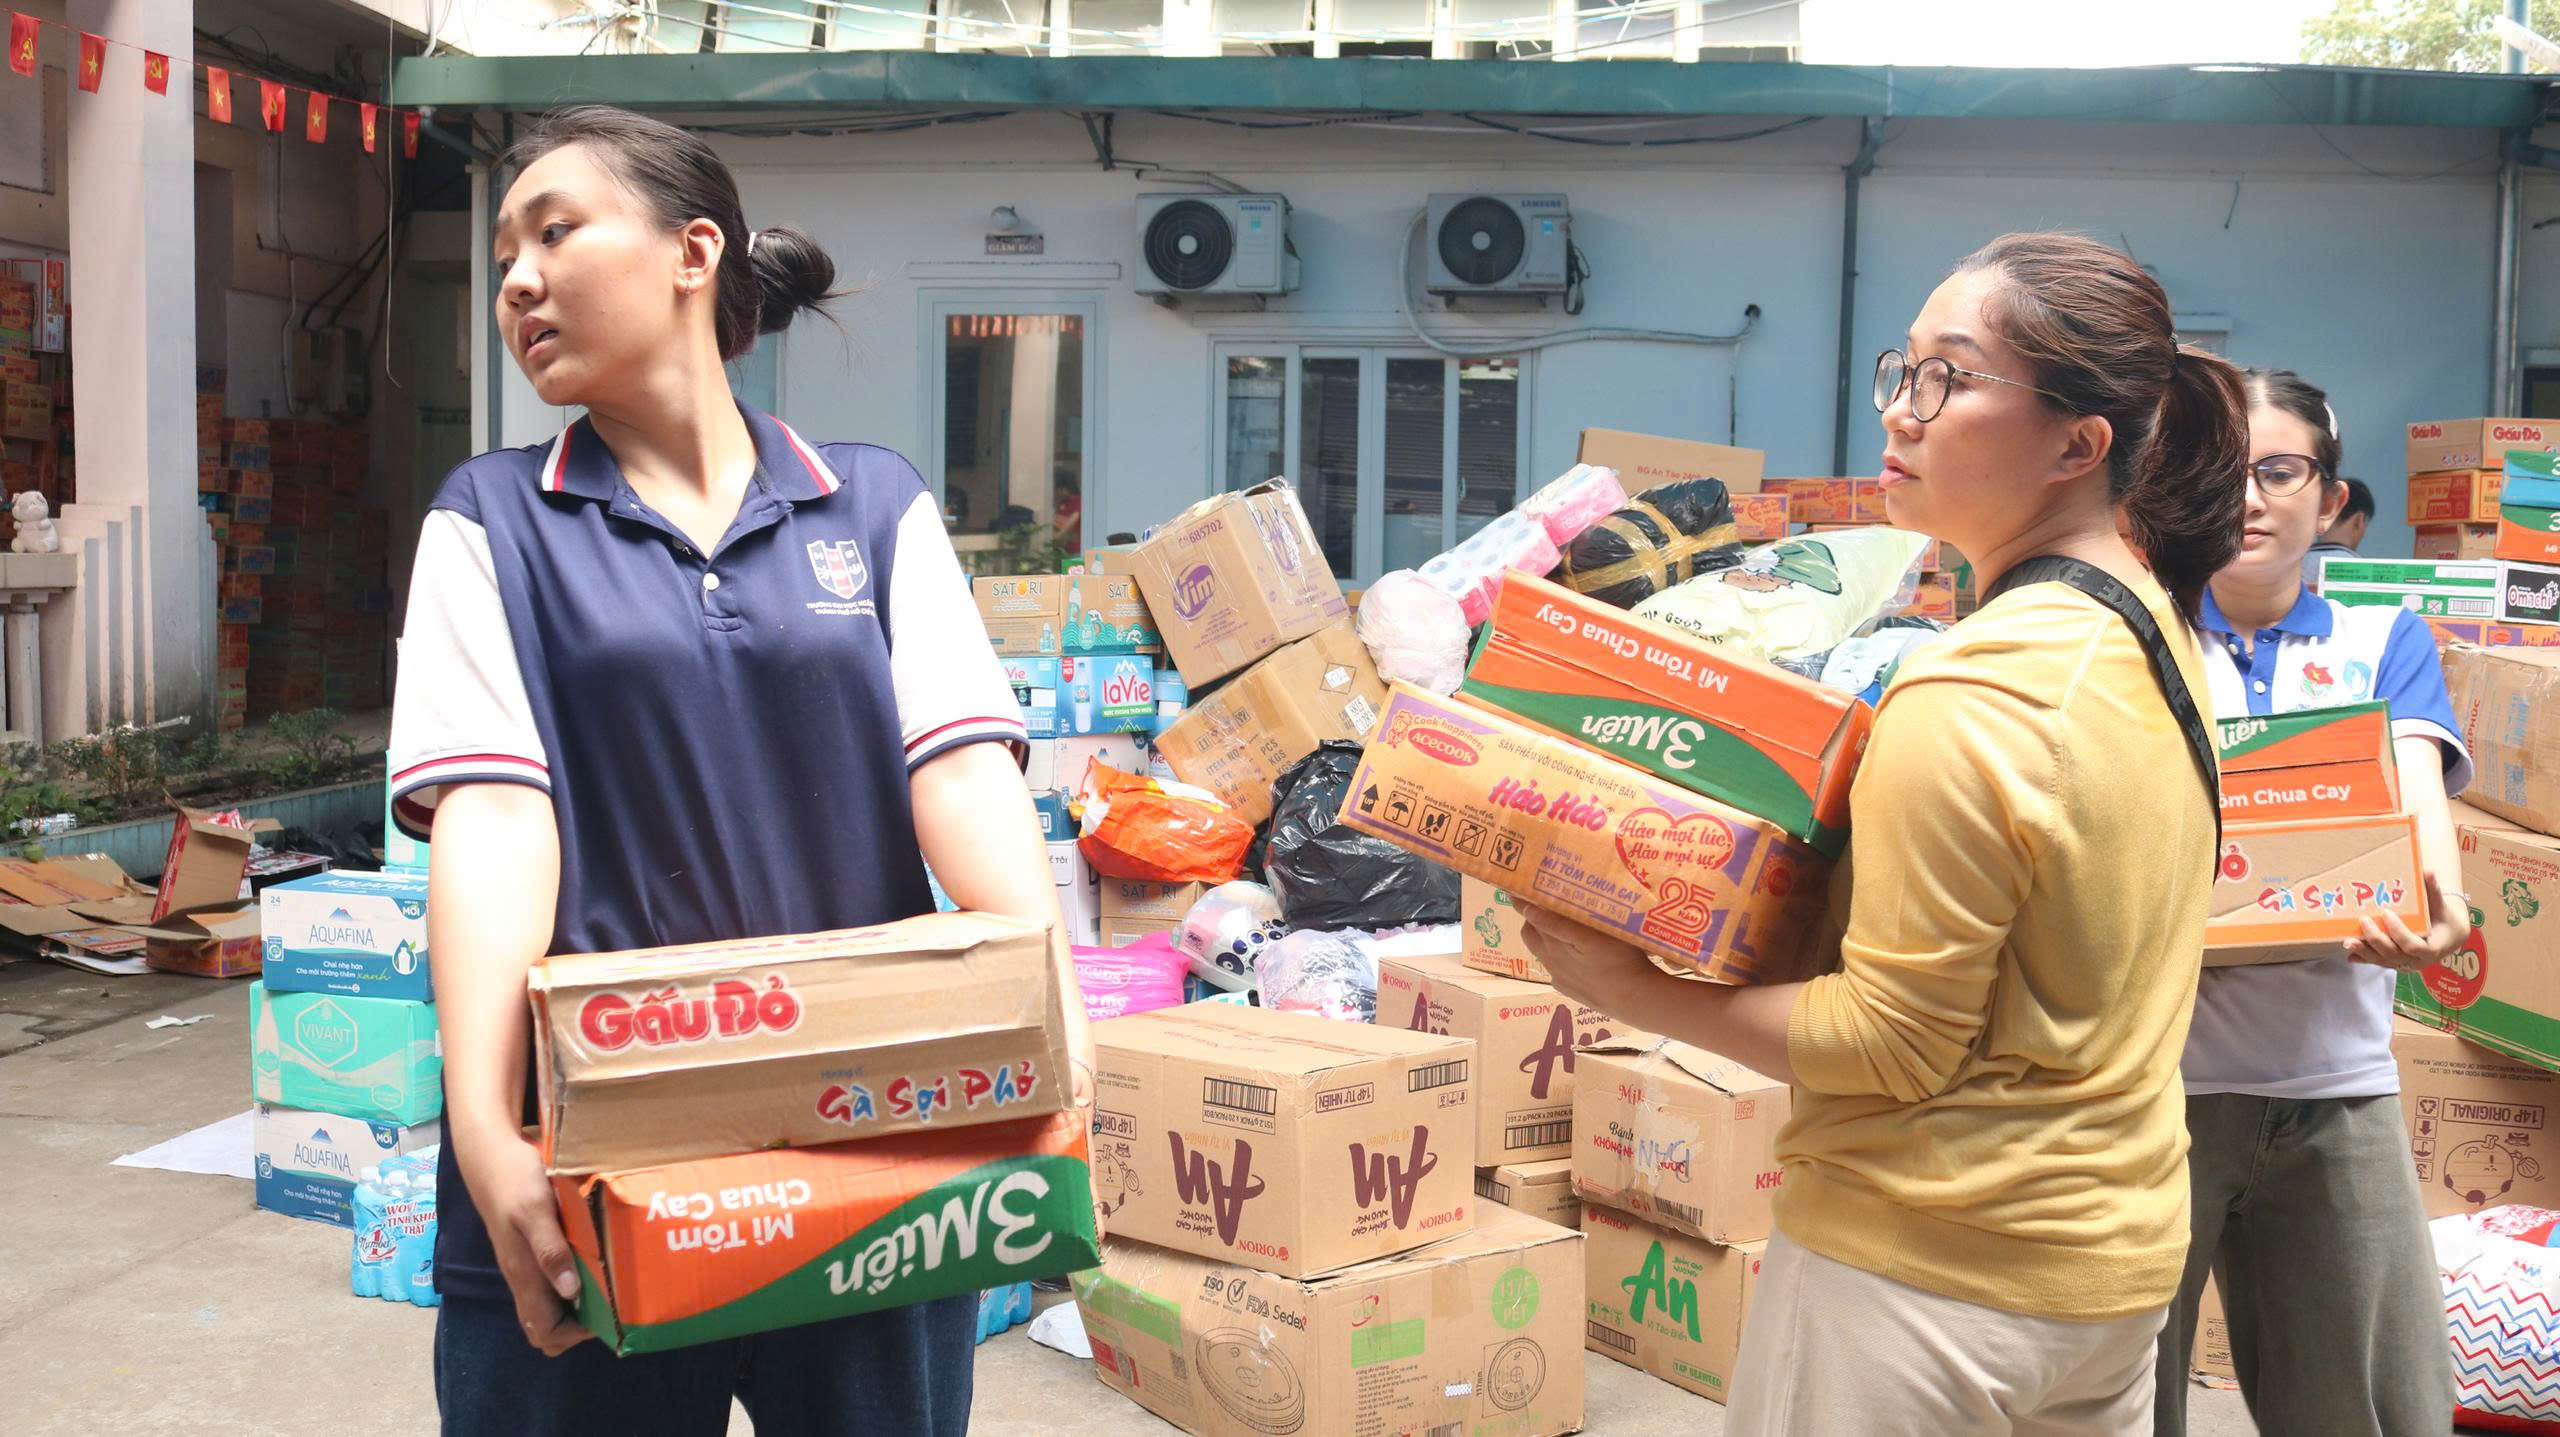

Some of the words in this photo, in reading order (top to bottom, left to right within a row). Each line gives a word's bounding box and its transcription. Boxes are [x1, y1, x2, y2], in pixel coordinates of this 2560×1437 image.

[1180, 572, 1215, 614] Vim
[1536, 603, 1577, 635] Cay
[1582, 621, 1639, 658] Chua
[1644, 646, 1692, 681] Tôm
[1104, 675, 1150, 704] laVie
[1698, 667, 1728, 694] Mì
[1414, 716, 1439, 726] Cook
[1488, 776, 1547, 816] Hảo
[1547, 791, 1608, 831] Hảo
[2253, 788, 2307, 805] Chua
[2311, 784, 2351, 801] Cay
[1662, 826, 1696, 847] mọi
[1648, 877, 1716, 937] 25
[2257, 887, 2295, 911] Gà
[2303, 884, 2344, 914] Sợi
[2352, 879, 2404, 906] Phở
[309, 924, 375, 948] AQUAFINA
[580, 986, 711, 1050] Gấu
[713, 976, 798, 1037] Đỏ
[1512, 1004, 1550, 1018] ORION
[302, 1024, 352, 1041] VIVANT
[816, 1081, 875, 1123] Gà
[887, 1075, 946, 1121] Sợi
[958, 1062, 1038, 1106] Phở
[2450, 1103, 2511, 1121] ORIGINAL
[2514, 1110, 2538, 1123] 14P
[1118, 1120, 1134, 1134] 14P
[1609, 1122, 1634, 1140] Bánh
[294, 1143, 351, 1174] AQUAFINA
[646, 1189, 714, 1222] Cay
[720, 1178, 810, 1210] Chua
[665, 1215, 747, 1253] Tôm
[756, 1212, 795, 1246] Mì
[1419, 1214, 1453, 1231] ORION
[1600, 1214, 1629, 1231] ORION
[1239, 1240, 1276, 1258] ORION
[1202, 1277, 1224, 1293] ISO
[1622, 1240, 1702, 1343] An
[1245, 1295, 1270, 1316] FDA
[1273, 1304, 1305, 1331] Sedex
